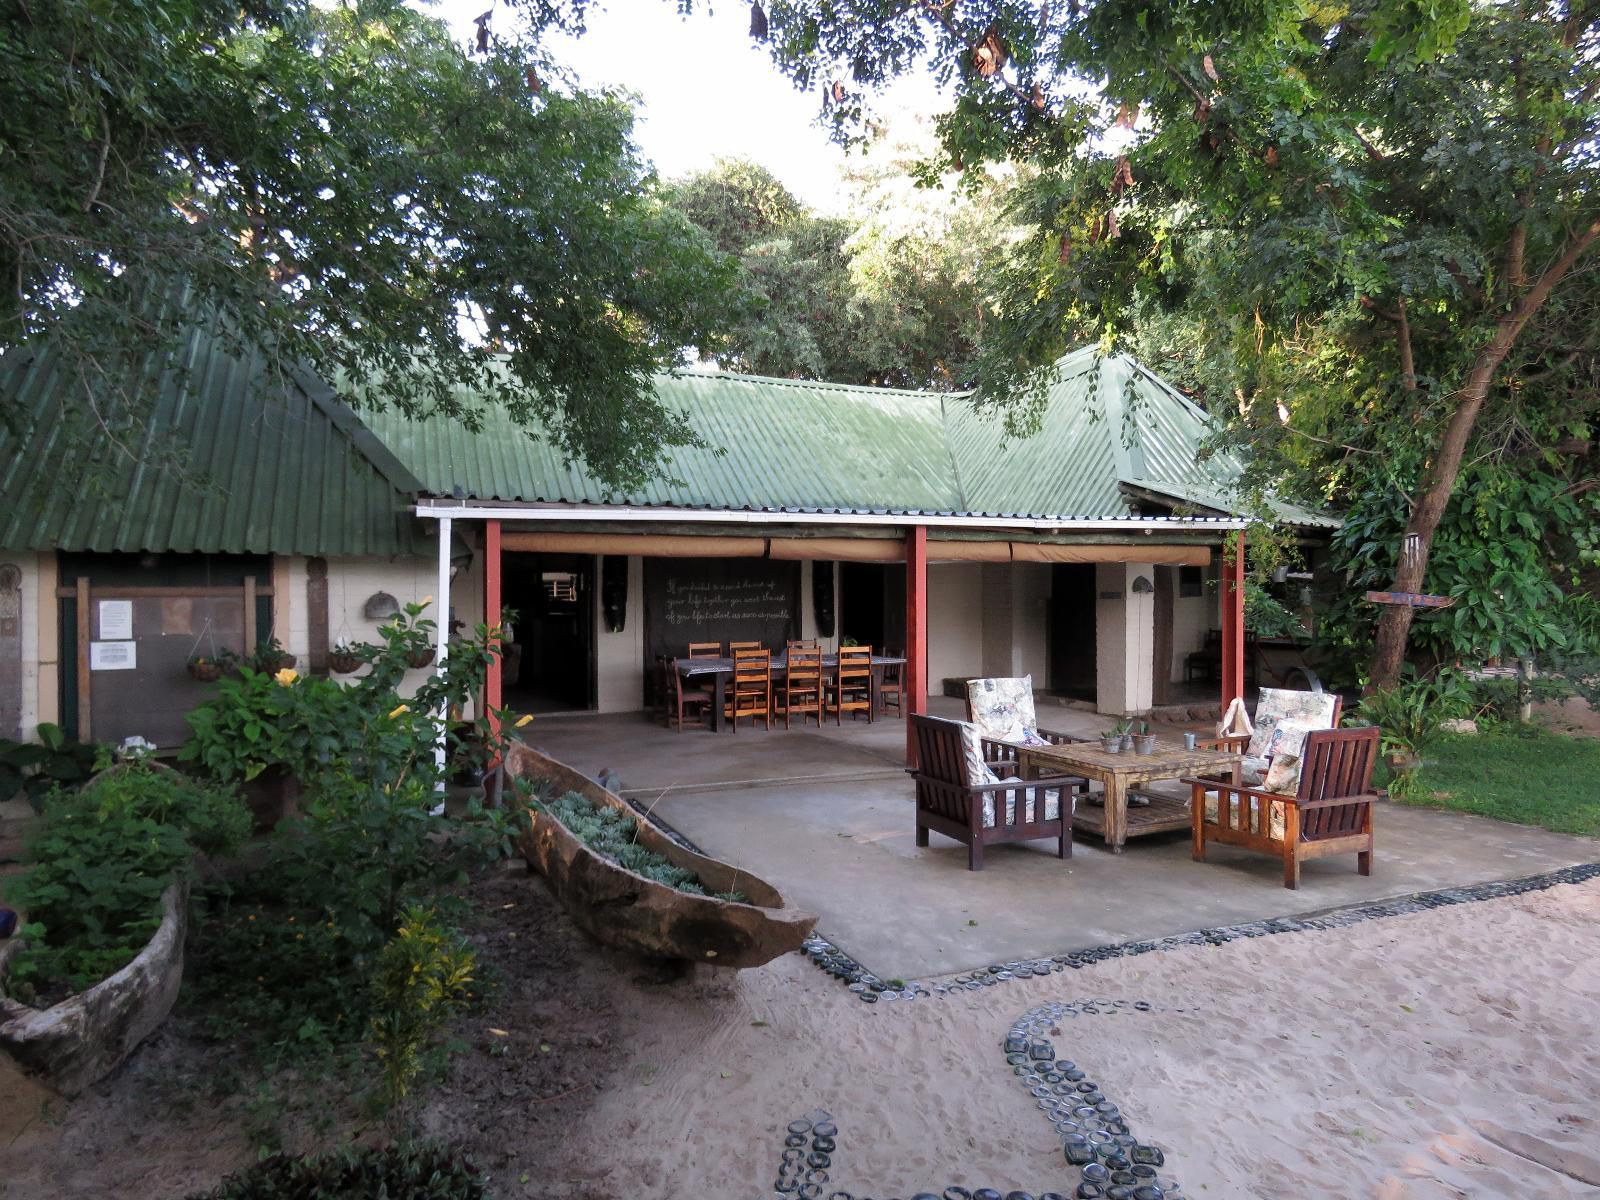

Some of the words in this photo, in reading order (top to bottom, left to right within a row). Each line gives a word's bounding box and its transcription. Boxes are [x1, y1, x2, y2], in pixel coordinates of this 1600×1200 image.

[687, 593, 703, 608] life
[704, 594, 729, 606] together
[665, 609, 676, 625] of
[692, 610, 705, 625] life
[705, 611, 712, 619] to
[713, 611, 730, 619] start
[765, 608, 791, 622] possible
